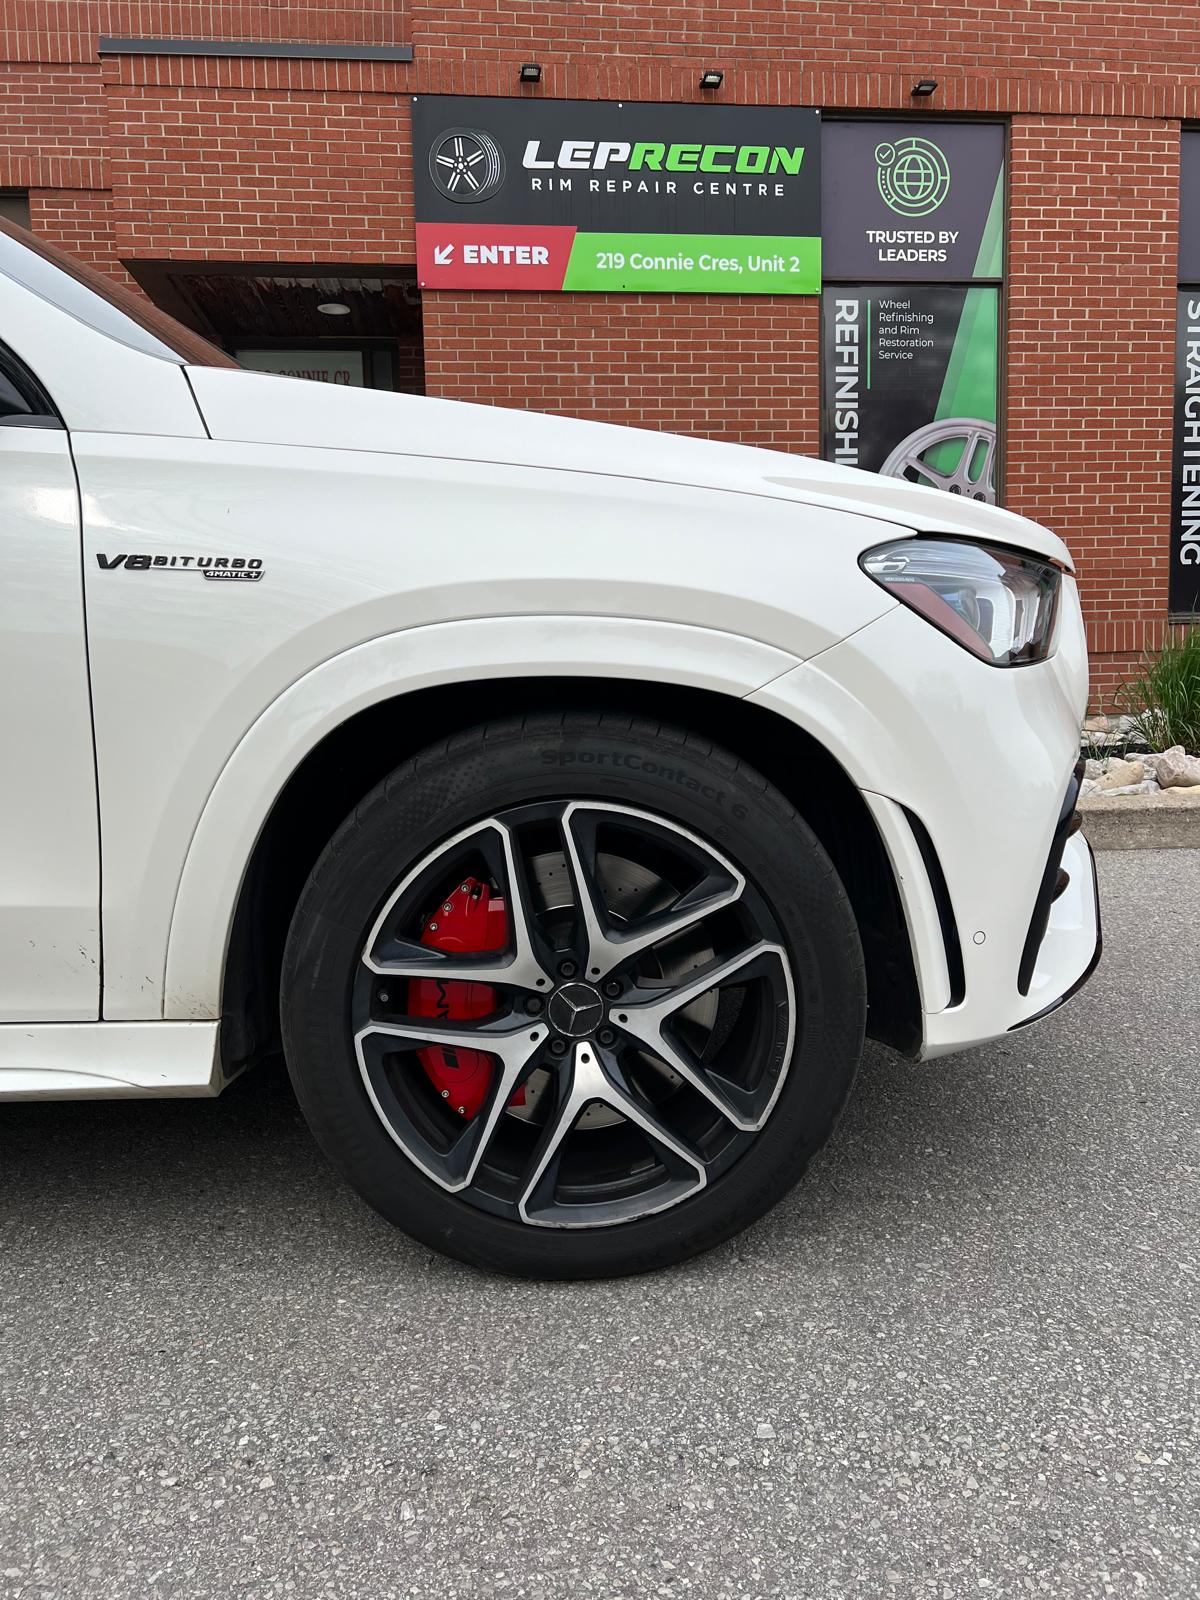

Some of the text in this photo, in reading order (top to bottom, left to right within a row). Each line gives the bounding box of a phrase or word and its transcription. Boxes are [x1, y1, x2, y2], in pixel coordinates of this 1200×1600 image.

[522, 140, 805, 175] LEPRECON
[531, 177, 784, 197] RIM REPAIR CENTRE
[866, 230, 959, 244] TRUSTED BY
[463, 244, 549, 265] ENTER
[878, 248, 947, 262] LEADERS
[596, 252, 801, 274] 219 Connie Cres, Unit 2
[878, 300, 911, 310] Wheel
[879, 312, 934, 324] Refinishing
[878, 325, 920, 335] and Rim
[879, 338, 934, 348] Restoration
[878, 350, 914, 360] Service
[540, 749, 749, 820] SportContact 6
